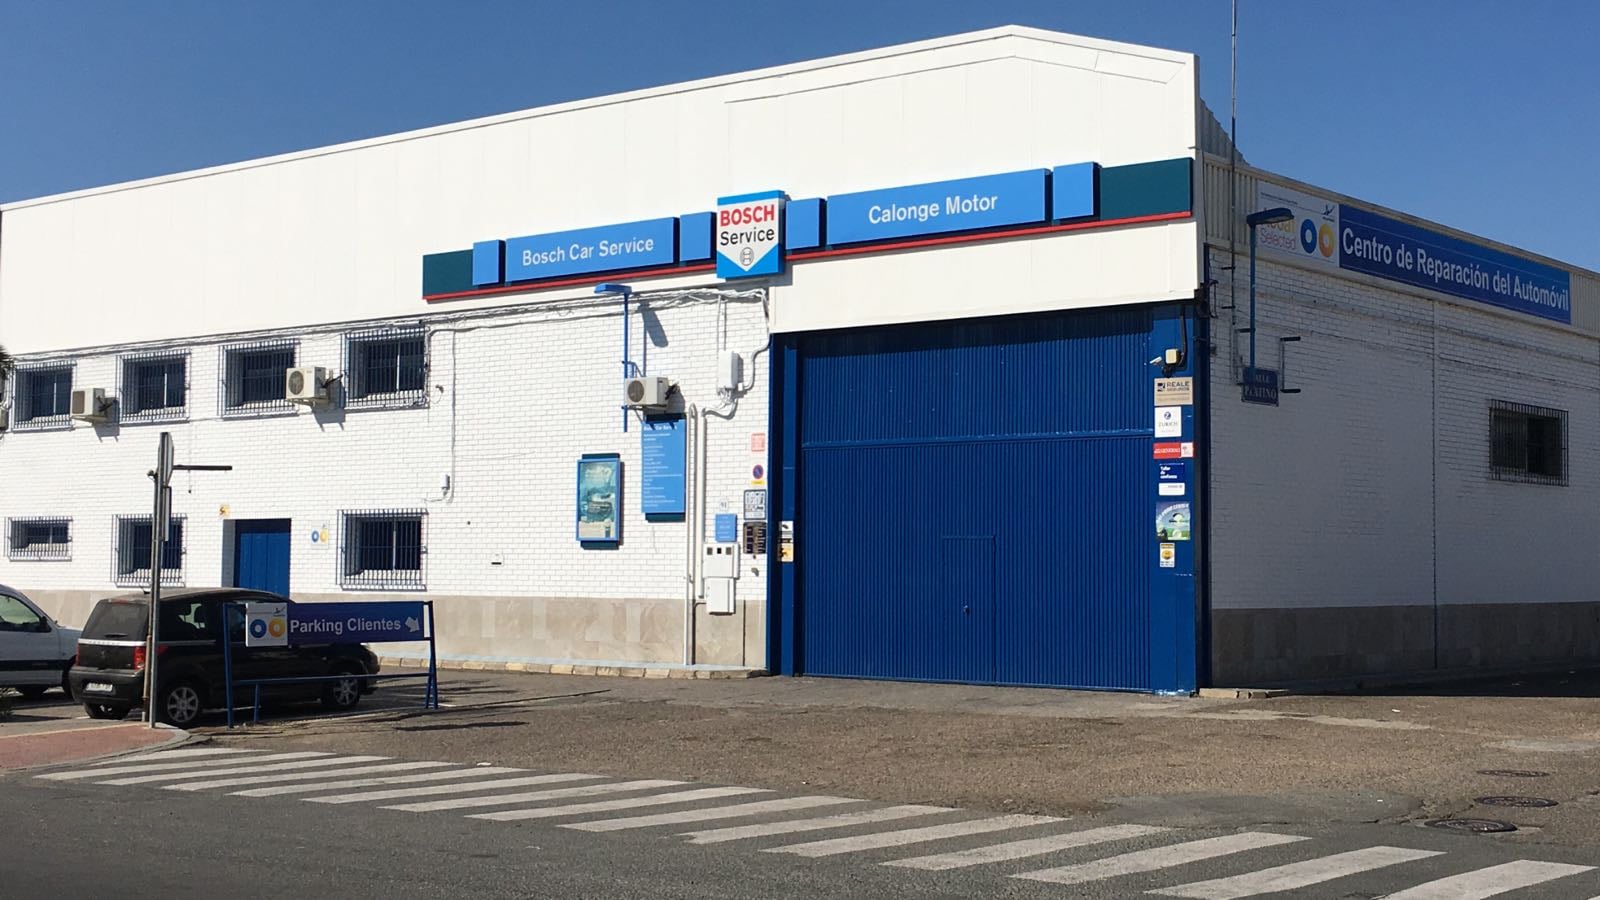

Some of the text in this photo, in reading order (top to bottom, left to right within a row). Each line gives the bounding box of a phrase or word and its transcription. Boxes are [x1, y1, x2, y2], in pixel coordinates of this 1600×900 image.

[720, 204, 775, 227] BOSCH
[868, 194, 998, 224] Calonge Motor
[720, 226, 775, 246] Service
[522, 237, 654, 266] Bosch Car Service
[1343, 227, 1569, 312] Centro de Reparación del Automóvil
[290, 616, 401, 635] Parking Clientes
